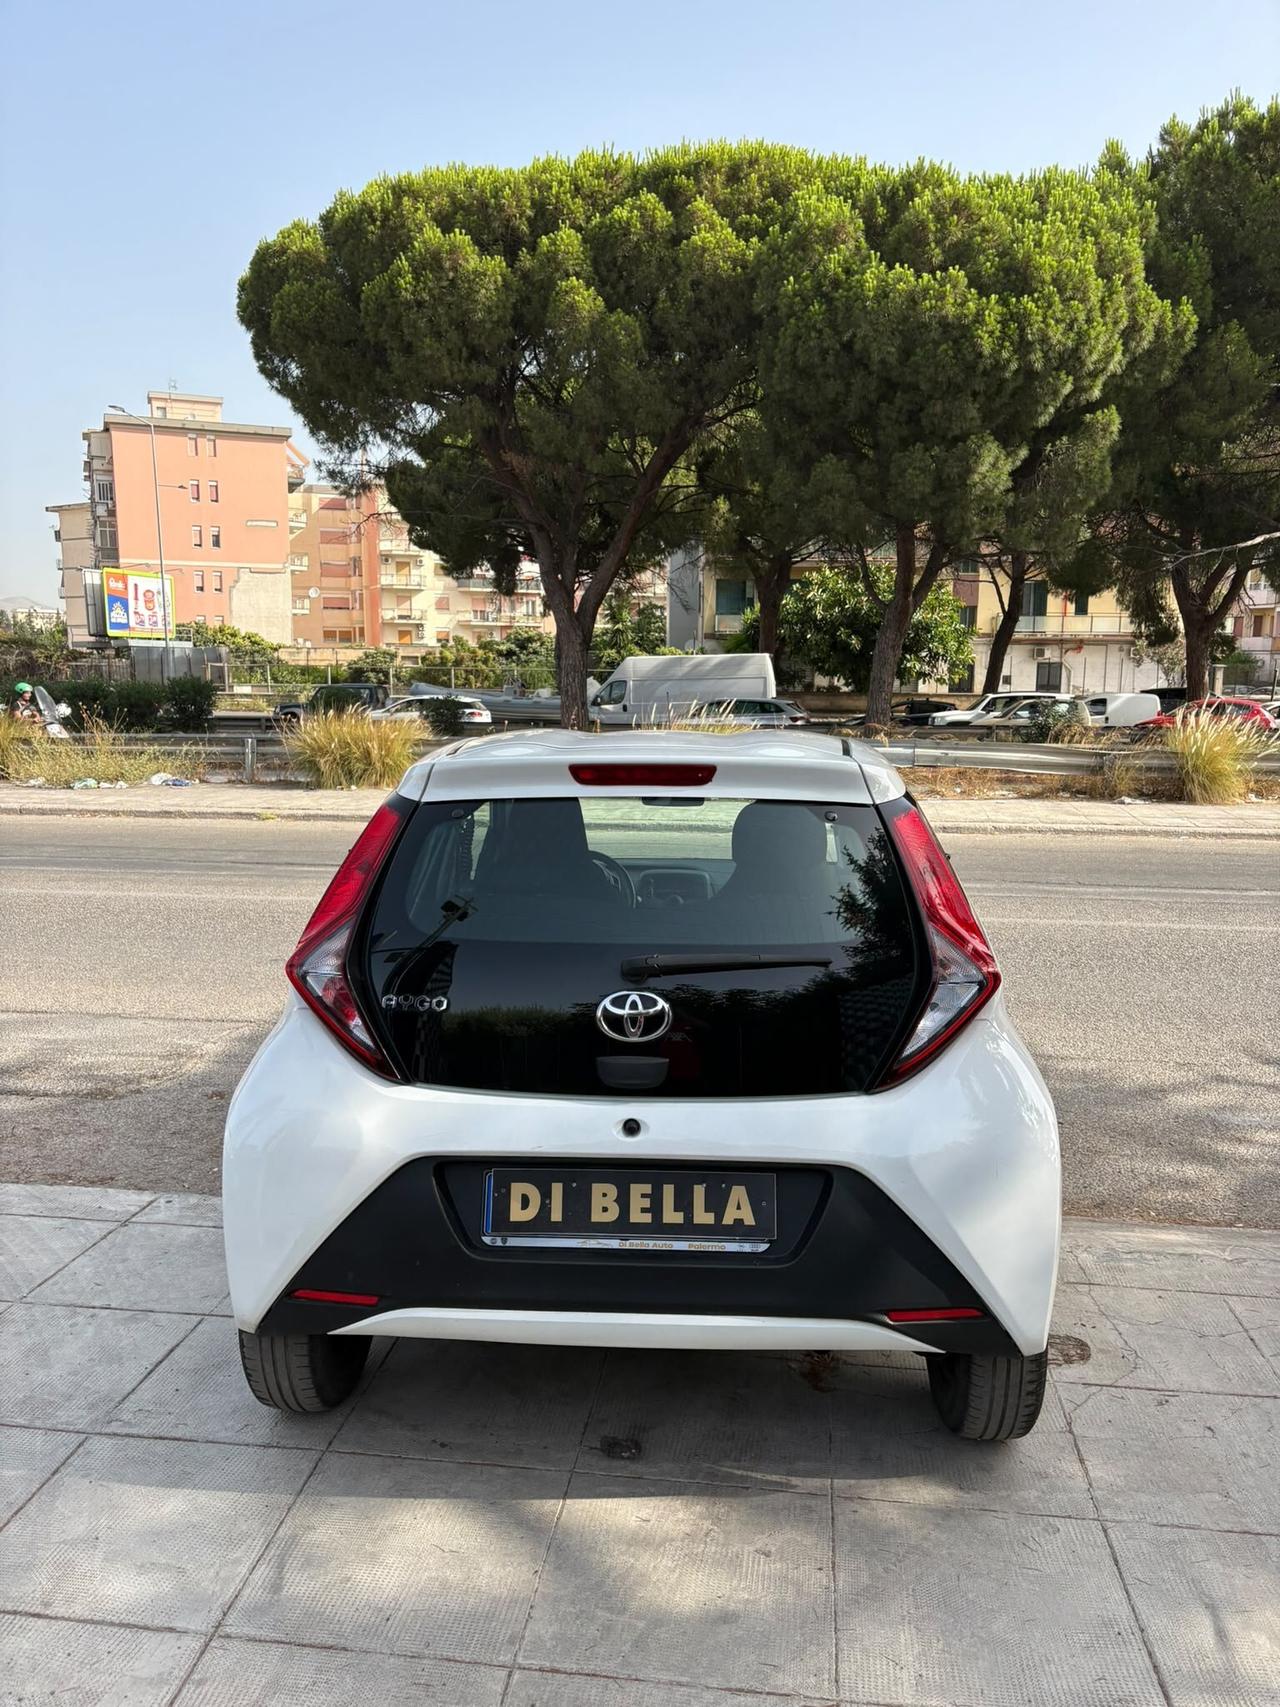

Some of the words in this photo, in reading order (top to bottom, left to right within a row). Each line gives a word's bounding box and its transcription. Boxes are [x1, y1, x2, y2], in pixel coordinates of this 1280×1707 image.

[381, 993, 448, 1012] AYGO
[509, 1182, 564, 1222] DI
[590, 1182, 756, 1226] BELLA
[628, 1241, 650, 1249] Bella
